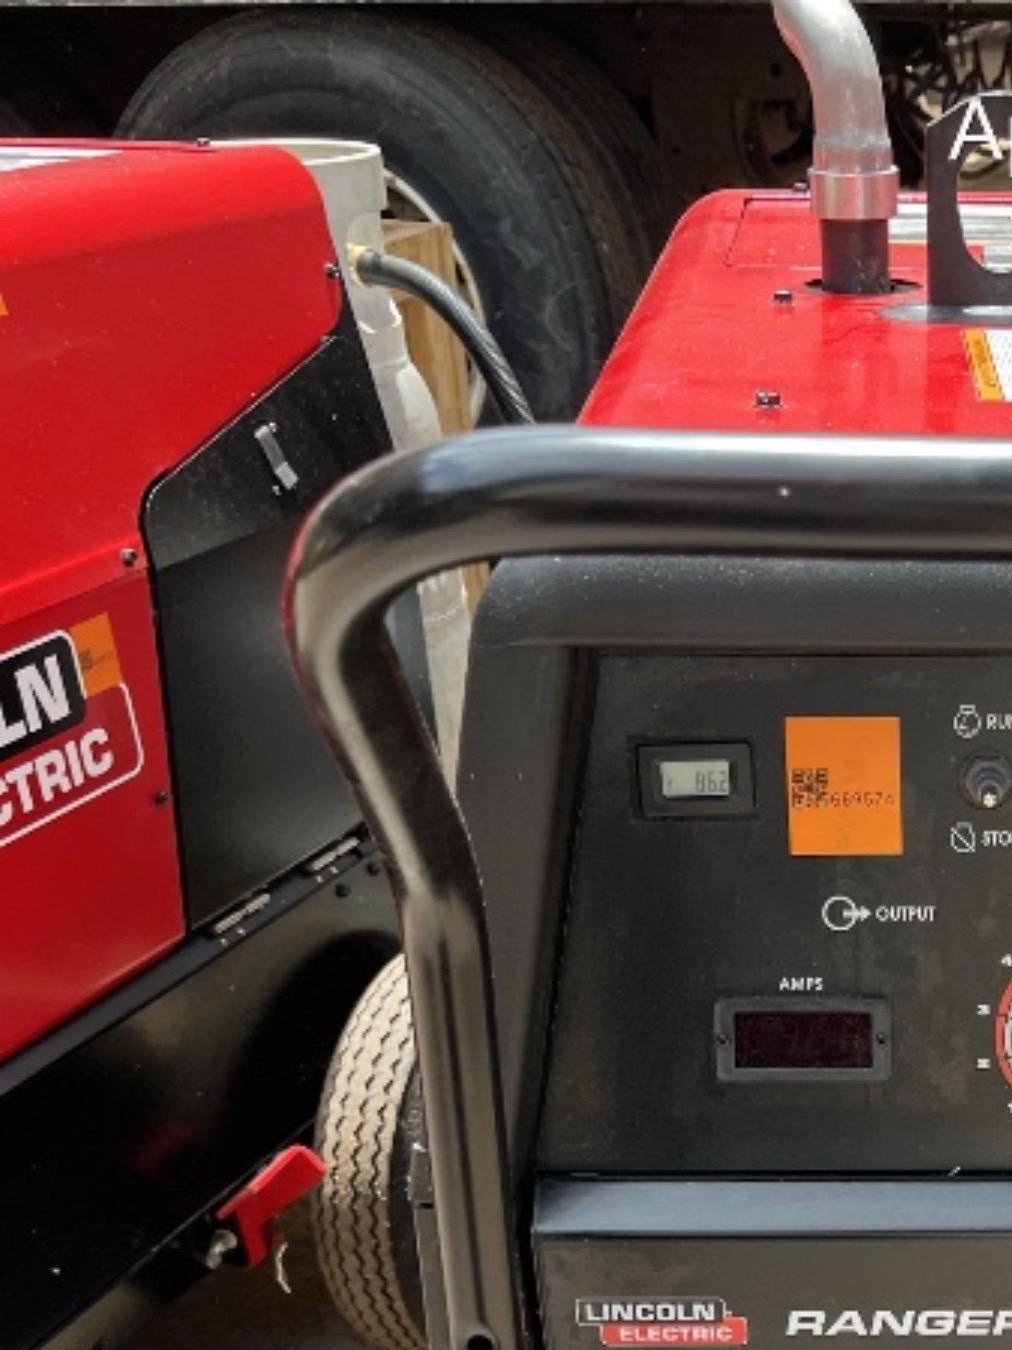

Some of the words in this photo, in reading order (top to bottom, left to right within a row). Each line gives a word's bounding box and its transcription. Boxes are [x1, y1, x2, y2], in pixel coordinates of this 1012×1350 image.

[875, 905, 936, 922] OUTPUT
[779, 977, 823, 991] AMPS
[585, 1303, 716, 1321] LINCOLN
[619, 1325, 733, 1342] ELECTRIC
